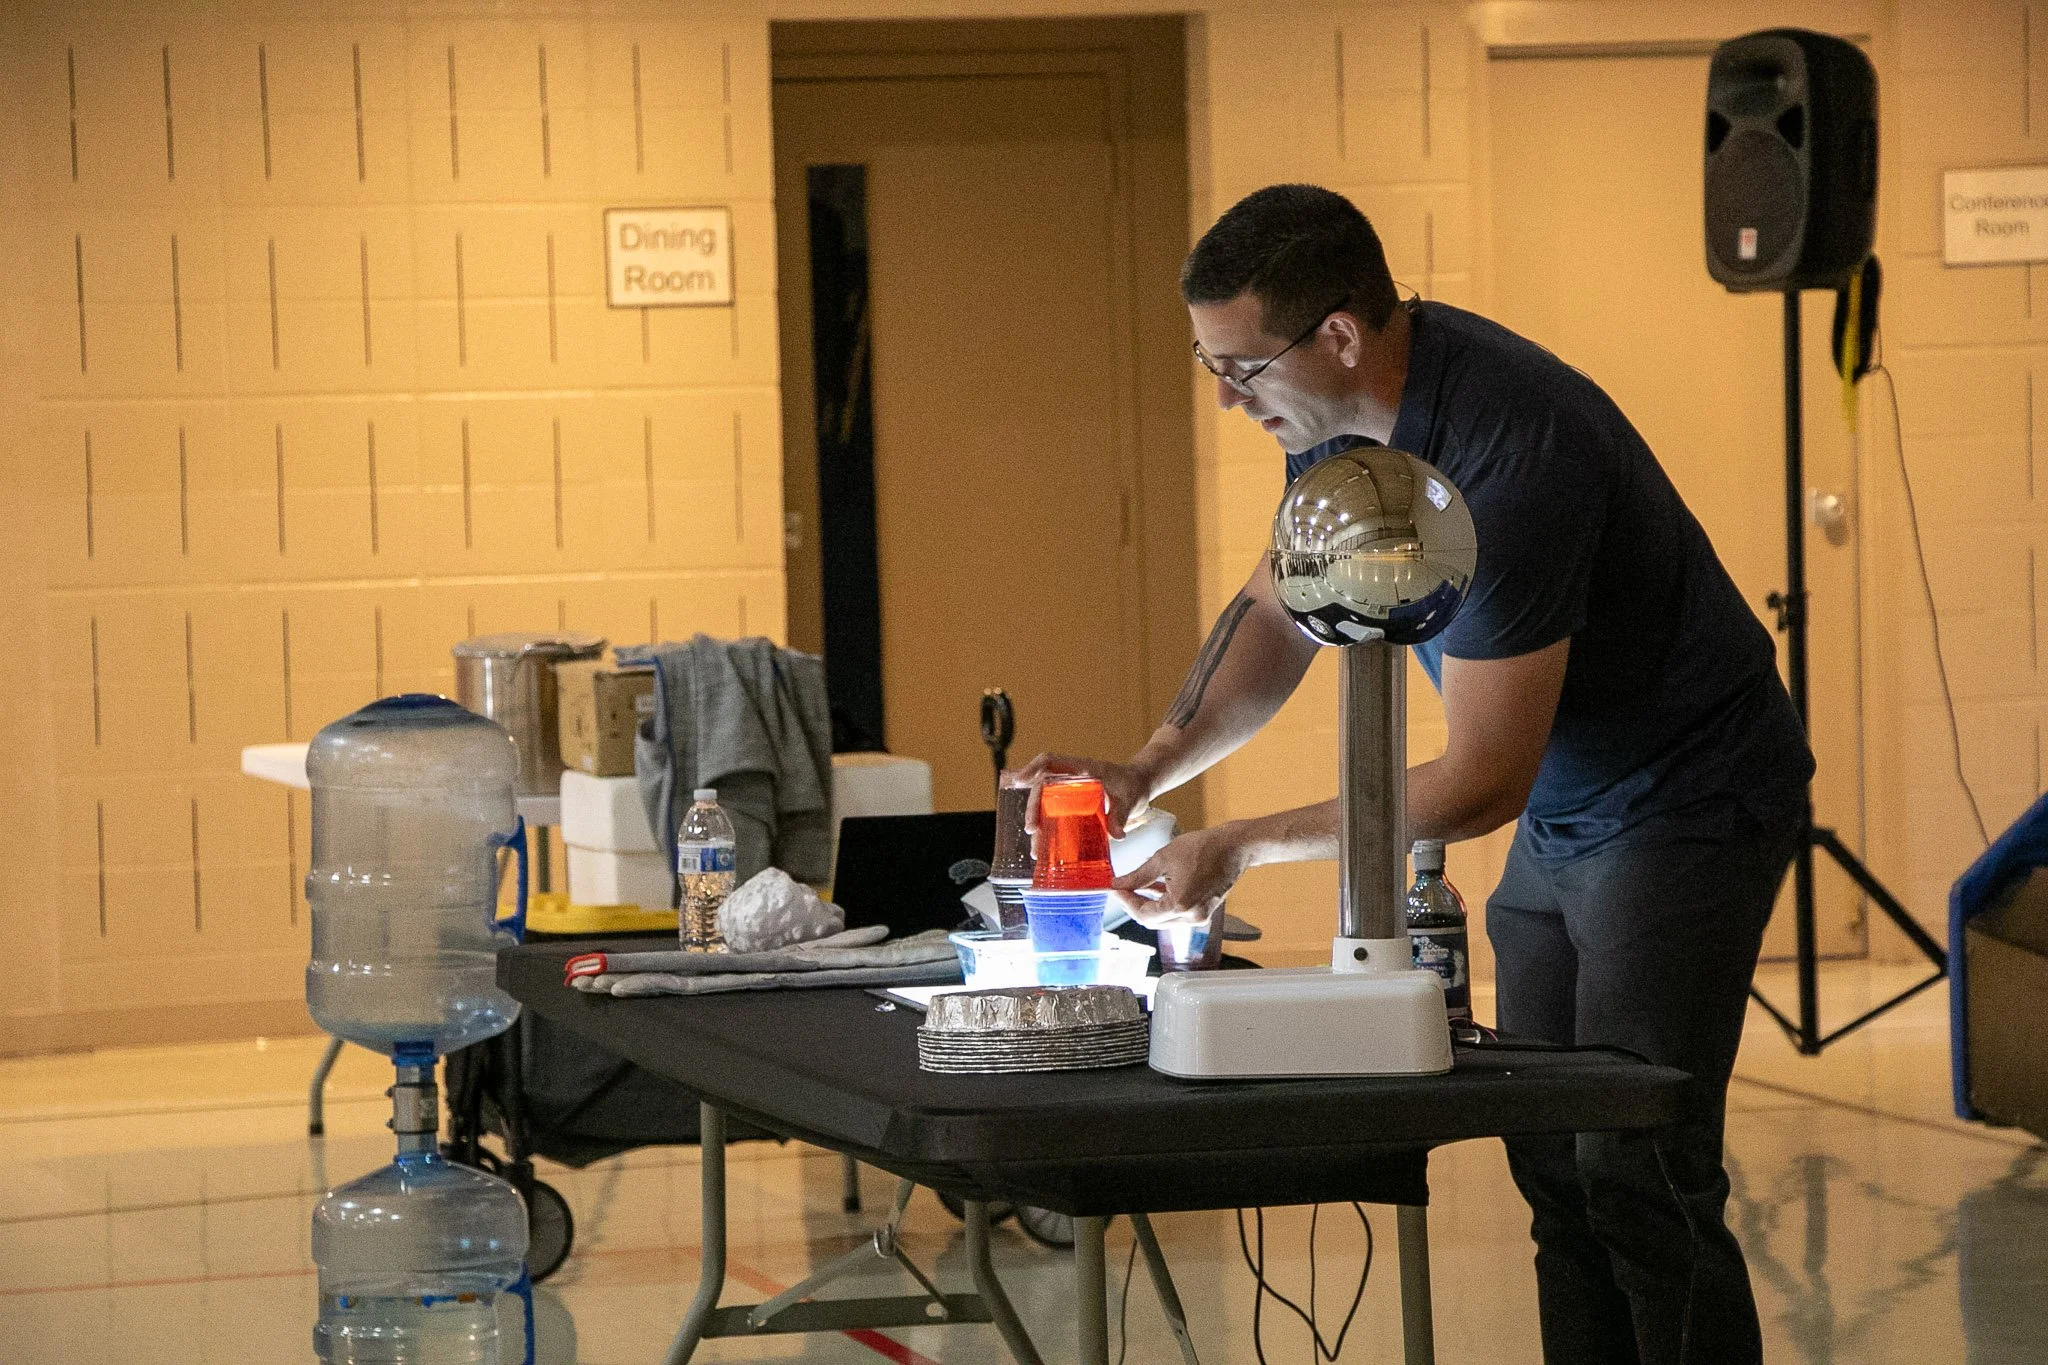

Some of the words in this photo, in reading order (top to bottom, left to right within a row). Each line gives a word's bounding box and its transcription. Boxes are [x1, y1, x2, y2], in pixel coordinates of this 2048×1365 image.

[619, 222, 717, 257] Dining
[1975, 218, 2030, 237] Room
[623, 264, 717, 294] Room
